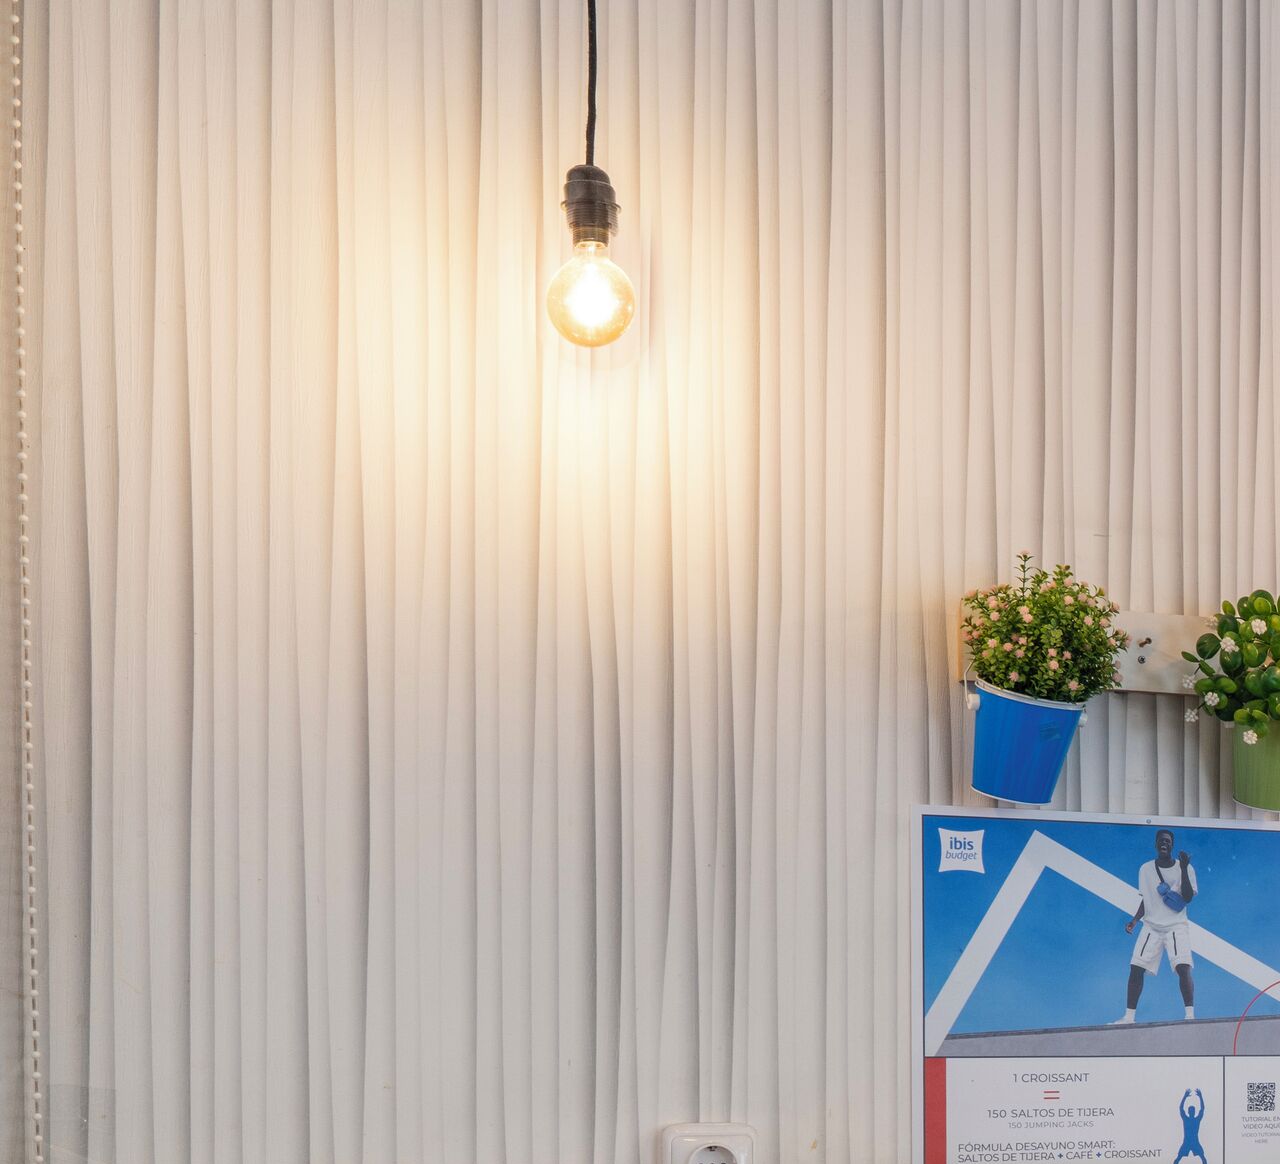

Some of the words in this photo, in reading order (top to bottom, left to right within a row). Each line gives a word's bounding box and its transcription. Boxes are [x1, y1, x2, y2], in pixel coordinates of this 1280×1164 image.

[950, 837, 974, 850] ibis
[945, 850, 977, 861] budget
[1013, 1073, 1017, 1082] 1
[1022, 1073, 1090, 1083] CROISSANT
[988, 1109, 1007, 1119] 150
[1010, 1109, 1055, 1118] SALTOS
[1058, 1108, 1074, 1118] DE
[1077, 1107, 1115, 1117] TIJERA
[1024, 1121, 1065, 1129] JUMPING
[958, 1141, 1013, 1153] FÓRMULA
[1015, 1141, 1075, 1151] DESAYUNO
[1077, 1140, 1116, 1150] SMART:
[958, 1153, 1000, 1163] SALTOS
[1002, 1152, 1016, 1162] DE
[1020, 1152, 1055, 1161] TIJERA
[1065, 1149, 1093, 1160] CAFÉ
[1104, 1149, 1162, 1159] CROISSANT
